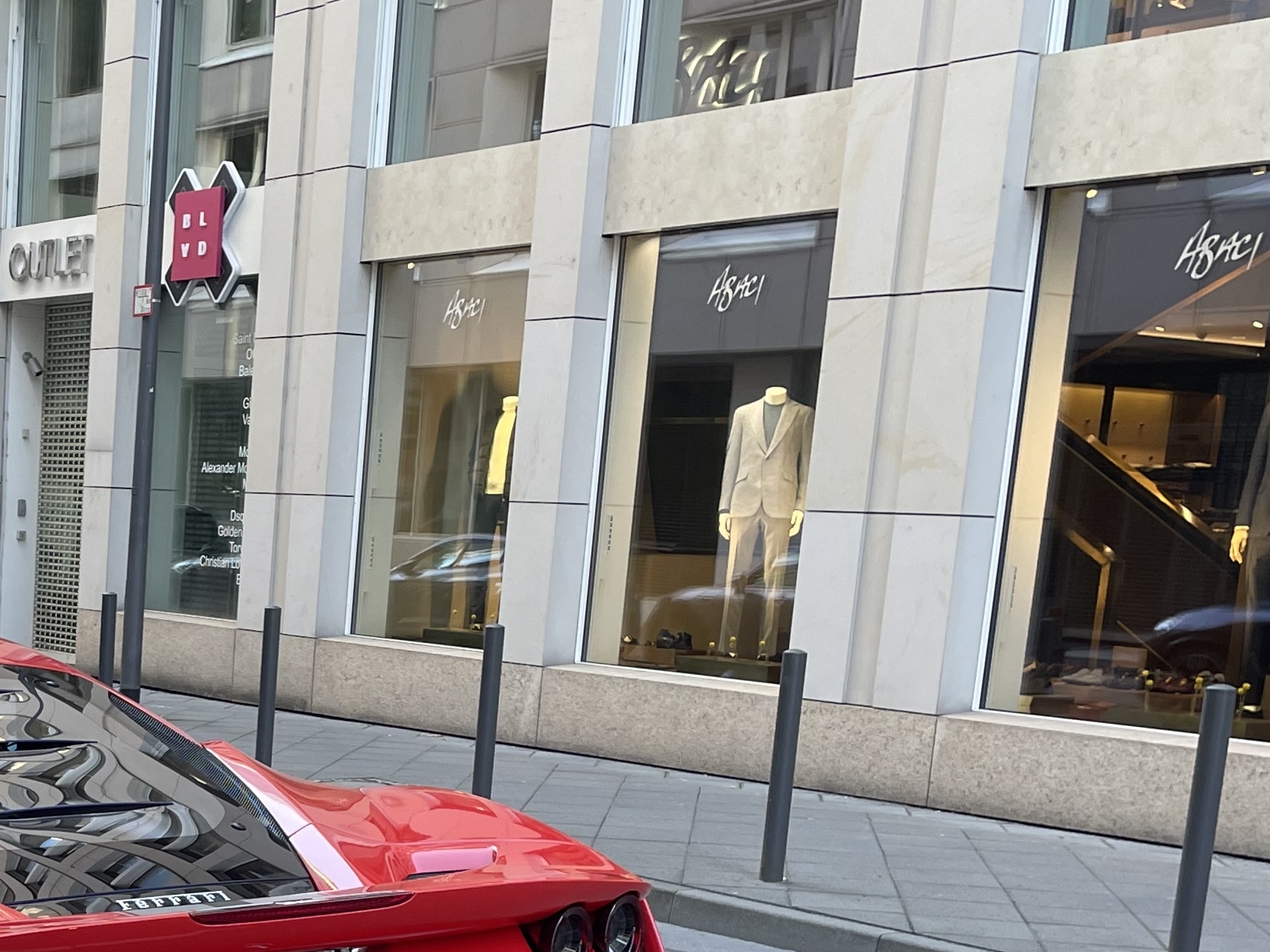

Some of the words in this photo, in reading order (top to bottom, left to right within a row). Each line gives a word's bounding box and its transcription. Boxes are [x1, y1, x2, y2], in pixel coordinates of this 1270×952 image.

[9, 234, 94, 282] OUTLET
[201, 461, 236, 473] Alexander
[218, 525, 242, 537] Golden
[199, 555, 229, 569] Christian
[116, 890, 231, 911] Ferrari
